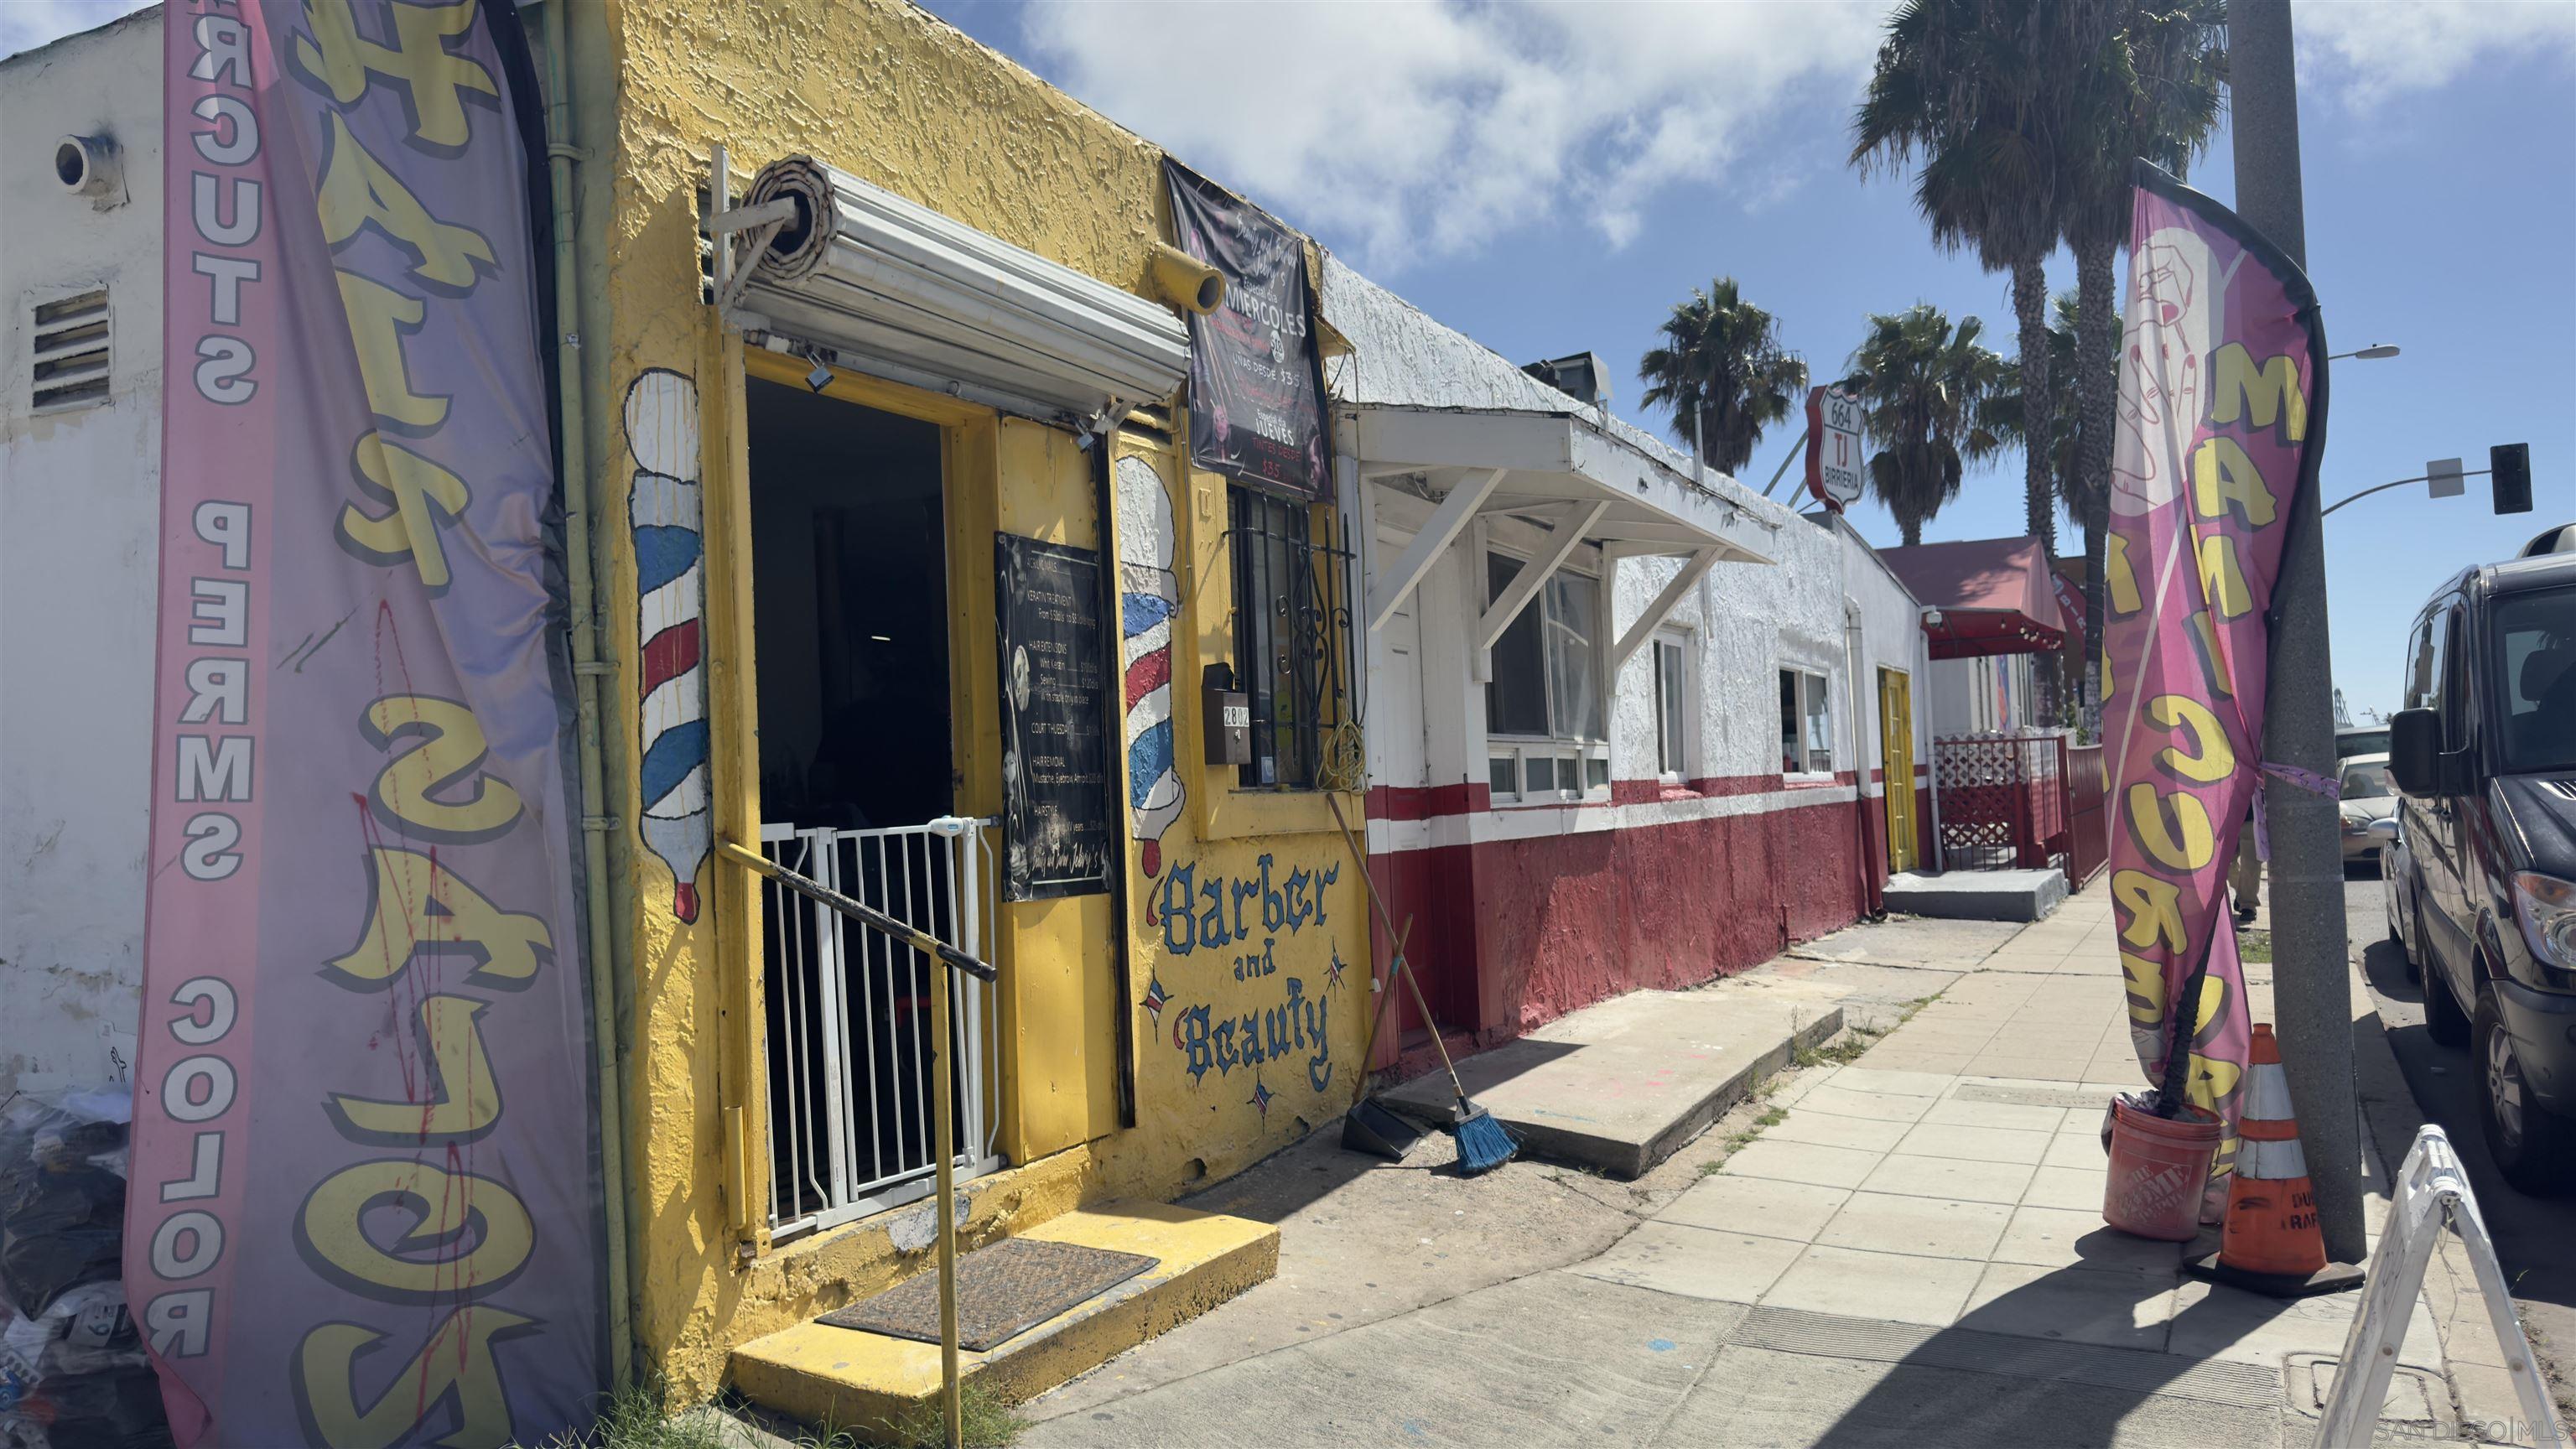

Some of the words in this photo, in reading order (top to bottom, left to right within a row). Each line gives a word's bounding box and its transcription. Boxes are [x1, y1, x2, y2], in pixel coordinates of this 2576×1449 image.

[1225, 283, 1306, 338] MIERCOLES
[1254, 361, 1276, 380] DESDE
[1831, 402, 1852, 430] 664
[1255, 418, 1295, 447] JUEVES
[1834, 432, 1848, 468] TJ
[1825, 465, 1859, 491] BIRRIERIA
[1031, 721, 1046, 735] COURT
[1223, 707, 1249, 727] 2802
[1147, 853, 1340, 956] Barber
[1233, 937, 1277, 982] and
[1173, 977, 1333, 1093] Beauty
